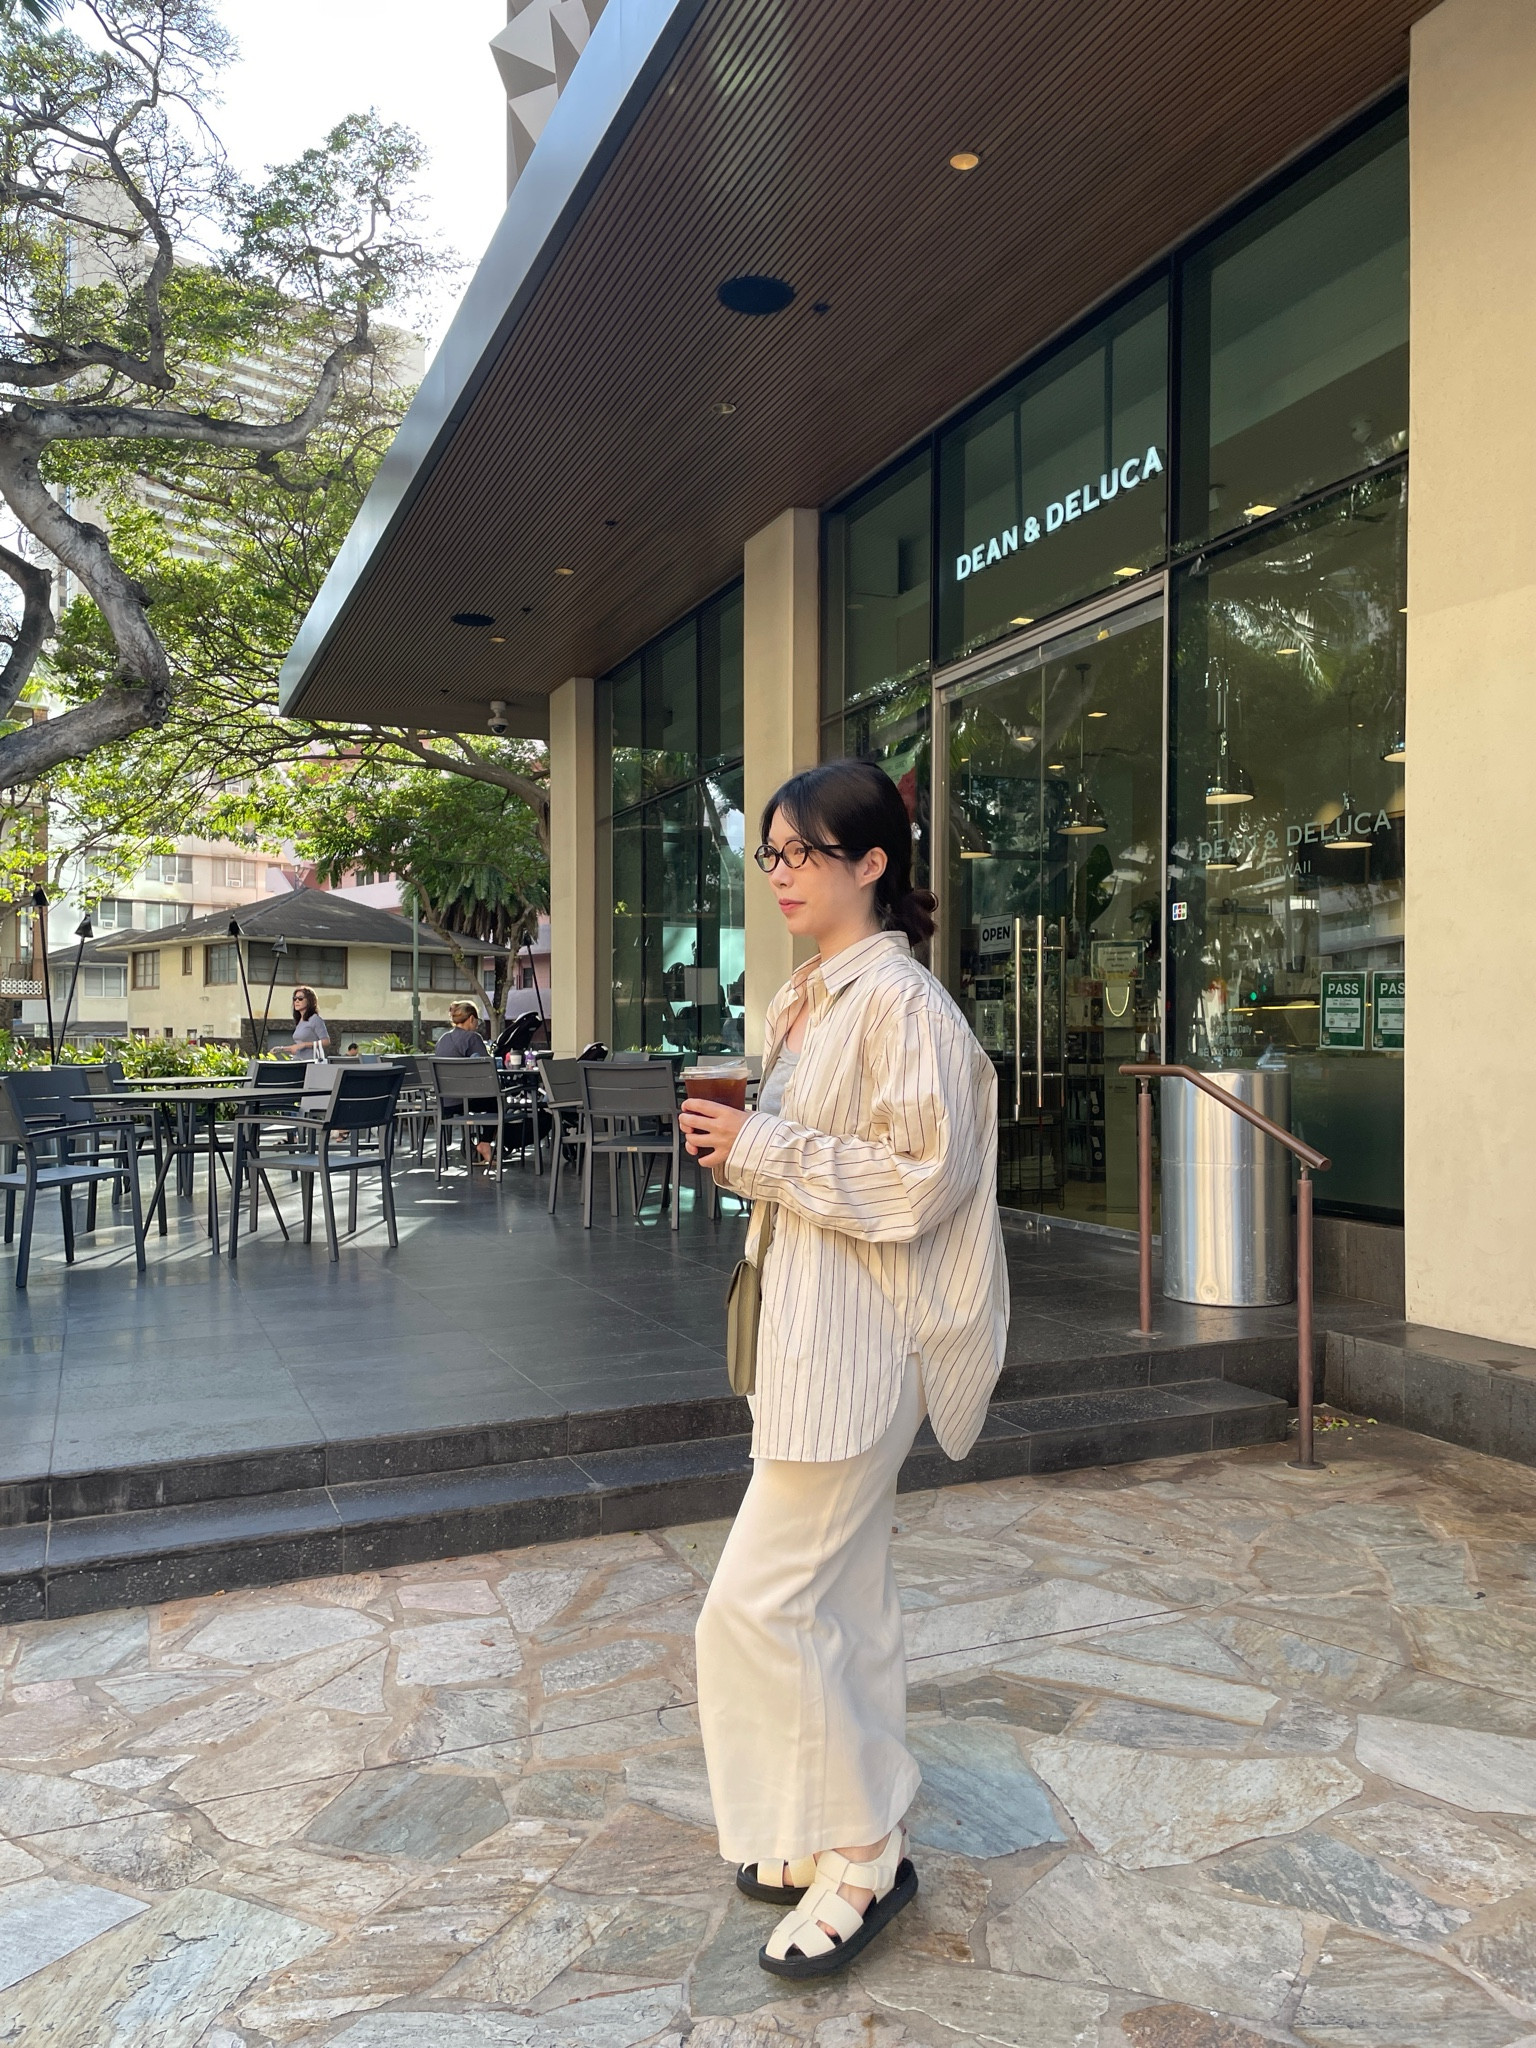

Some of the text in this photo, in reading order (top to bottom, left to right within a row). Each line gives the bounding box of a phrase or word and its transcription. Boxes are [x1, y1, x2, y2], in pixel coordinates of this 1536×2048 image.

[956, 446, 1164, 581] DEAN & DELUCA
[1199, 809, 1392, 862] DEAN & DELUCA
[1263, 860, 1312, 879] HAWAII
[982, 925, 1011, 943] OPEN
[1328, 983, 1359, 995] PASS
[1380, 983, 1405, 995] PAS
